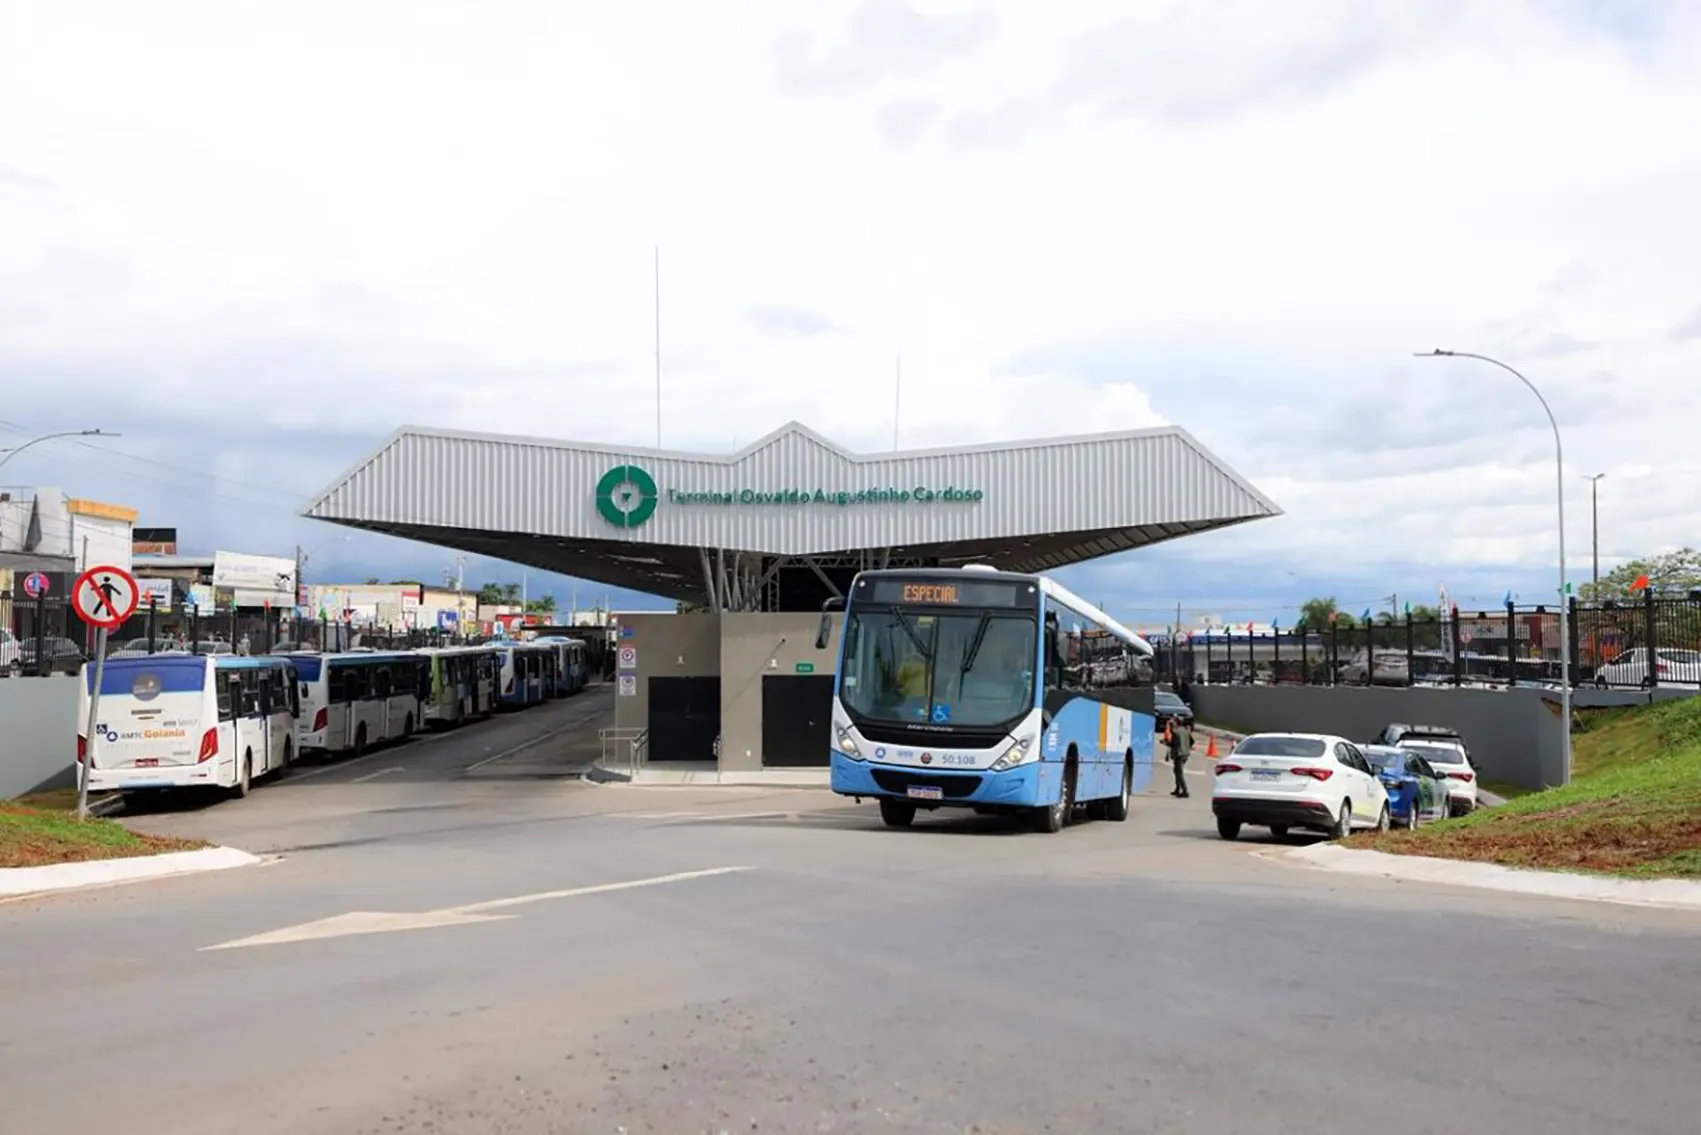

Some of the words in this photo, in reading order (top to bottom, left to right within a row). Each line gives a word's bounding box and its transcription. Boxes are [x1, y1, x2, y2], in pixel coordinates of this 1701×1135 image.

[666, 488, 737, 503] Terminal
[740, 488, 811, 504] Osvaldo
[813, 486, 910, 506] Augustinho
[914, 486, 984, 503] Cardoso
[904, 585, 959, 603] ESPECIAL
[942, 754, 976, 765] 50.108
